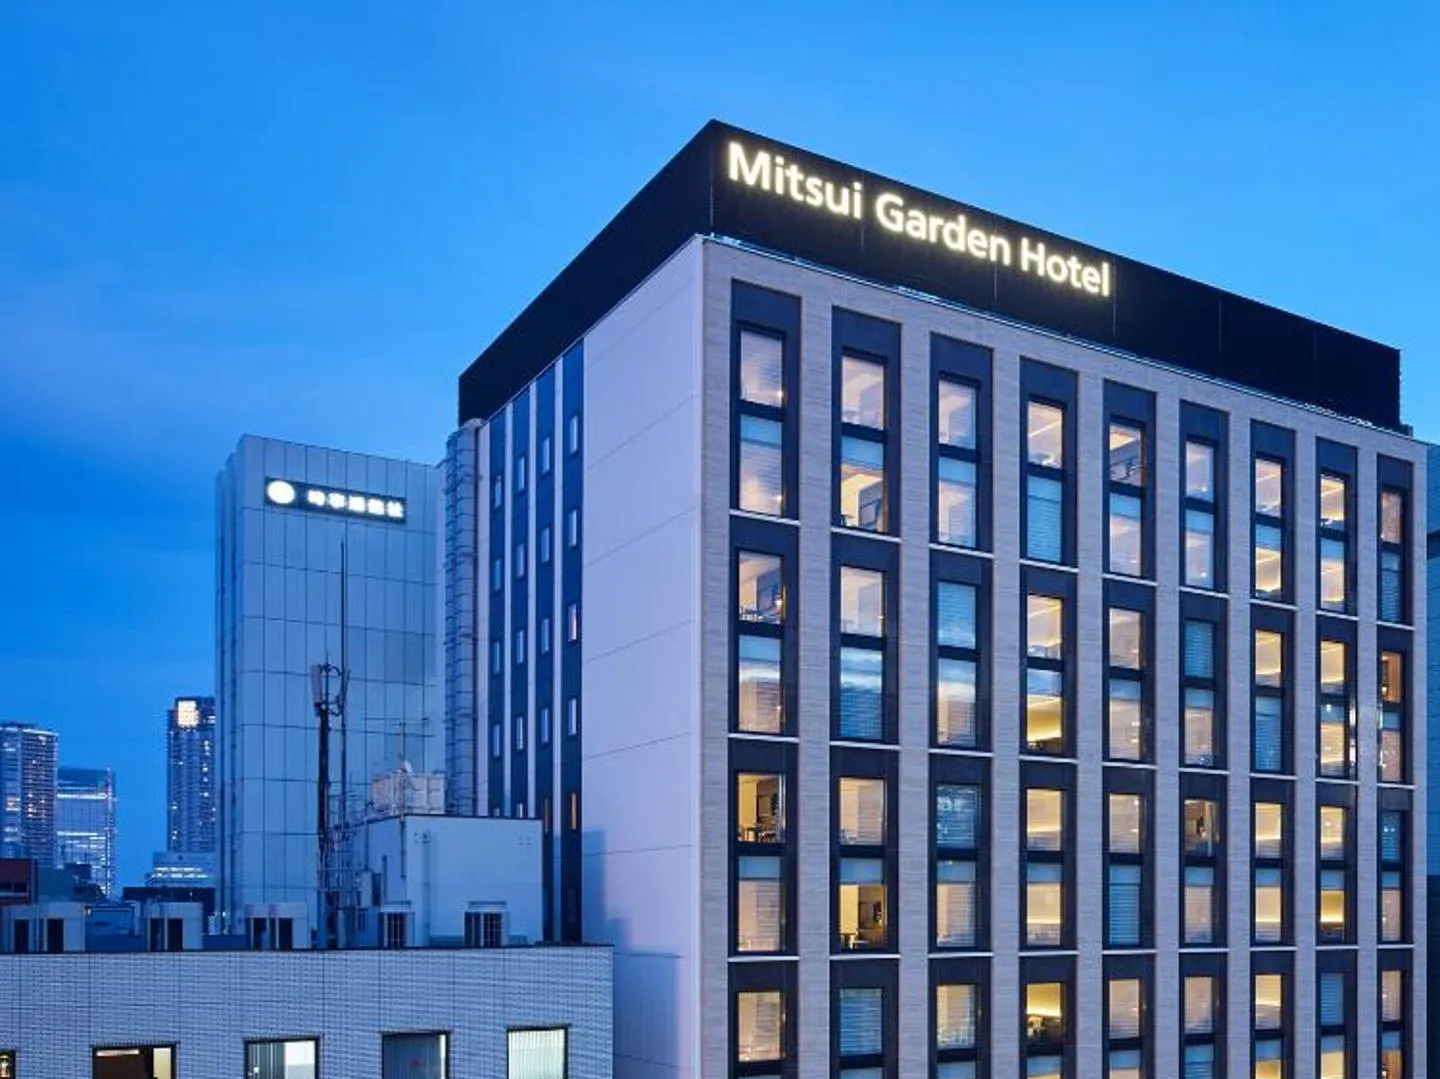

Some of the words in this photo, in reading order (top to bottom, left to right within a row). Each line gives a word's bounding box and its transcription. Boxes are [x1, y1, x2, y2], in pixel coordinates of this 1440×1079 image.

[727, 141, 864, 221] Mitsui
[873, 191, 1012, 267] Garden
[1019, 236, 1111, 298] Hotel
